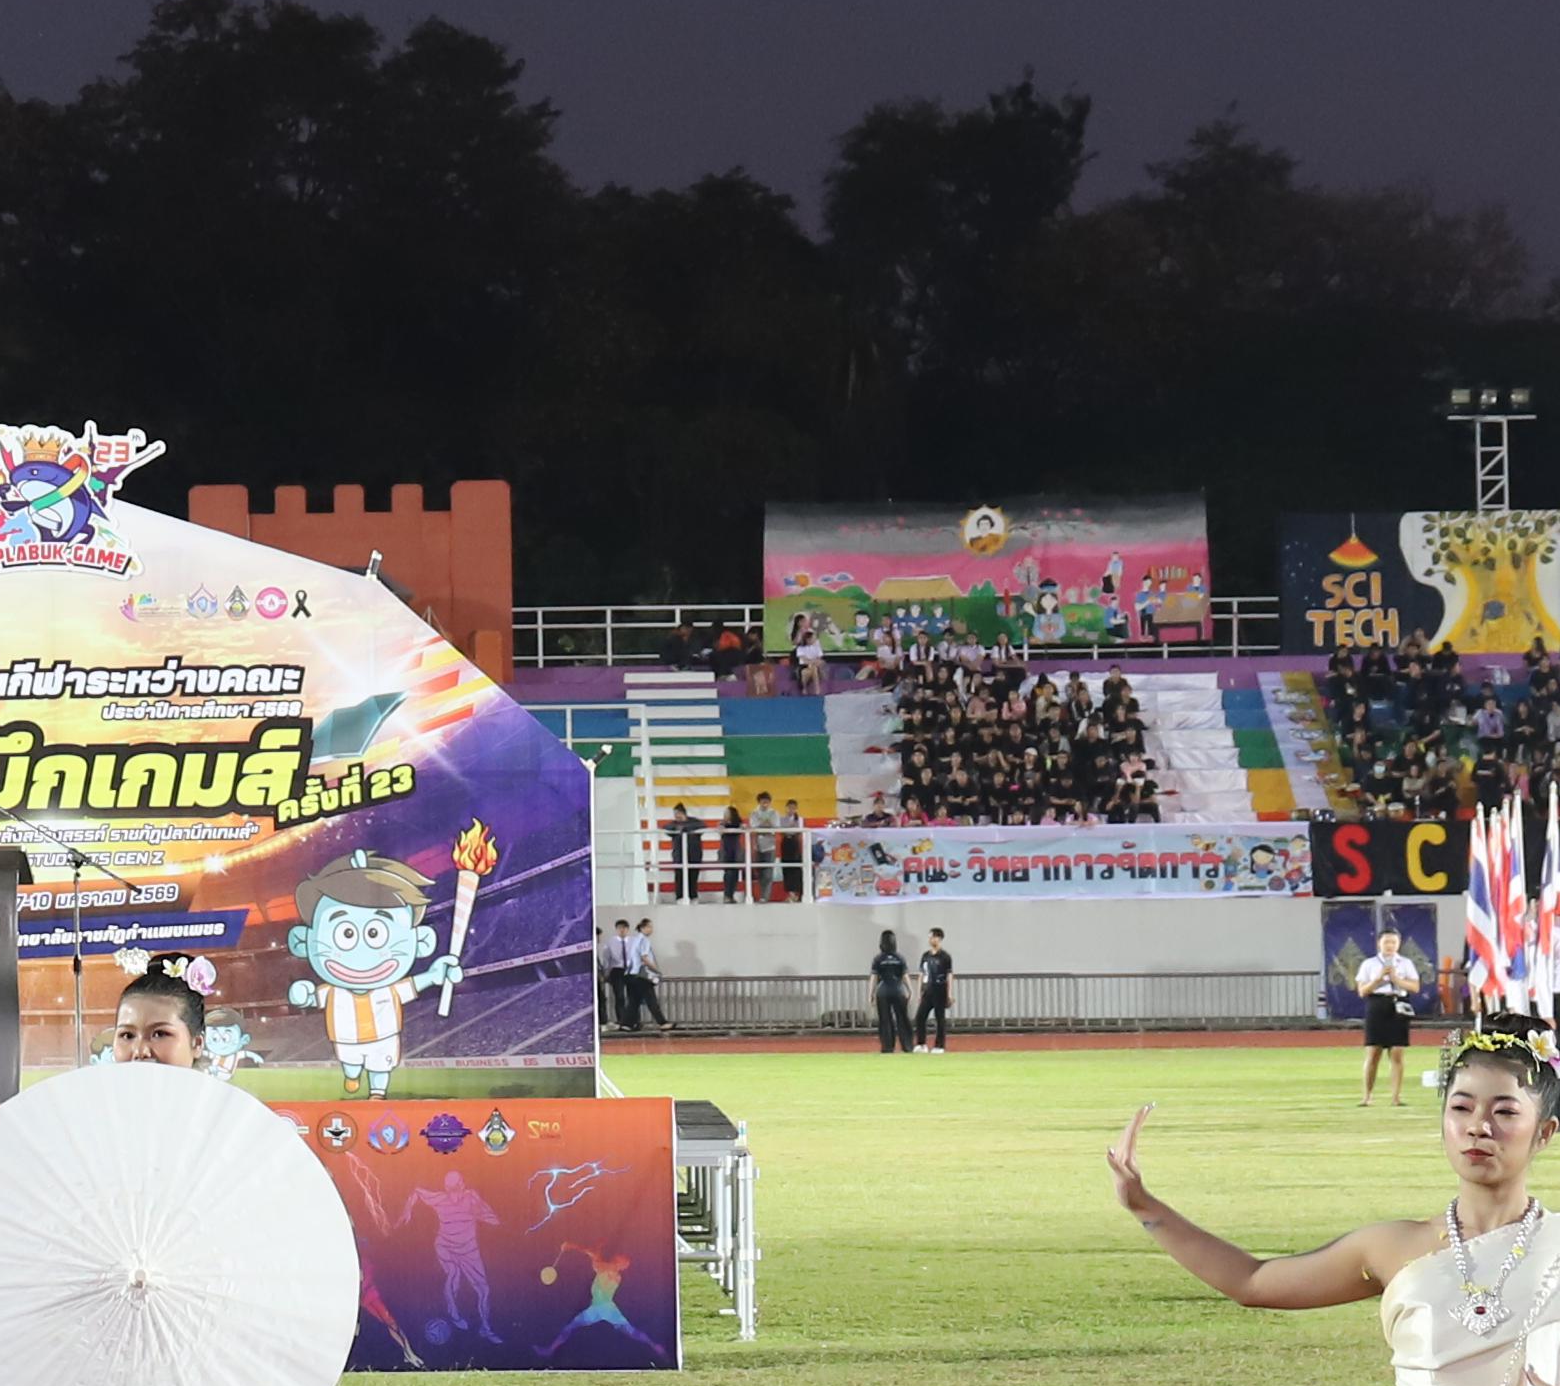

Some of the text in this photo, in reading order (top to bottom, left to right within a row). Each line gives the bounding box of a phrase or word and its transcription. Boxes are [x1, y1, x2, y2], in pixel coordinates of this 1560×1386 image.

[72, 545, 127, 570] GAME
[1322, 571, 1382, 608] SCI
[1306, 608, 1399, 648] TECH
[277, 764, 415, 824] ครั้งที่ 23
[27, 851, 111, 867] STUDTS
[113, 851, 149, 866] GEN
[150, 851, 166, 866] Z
